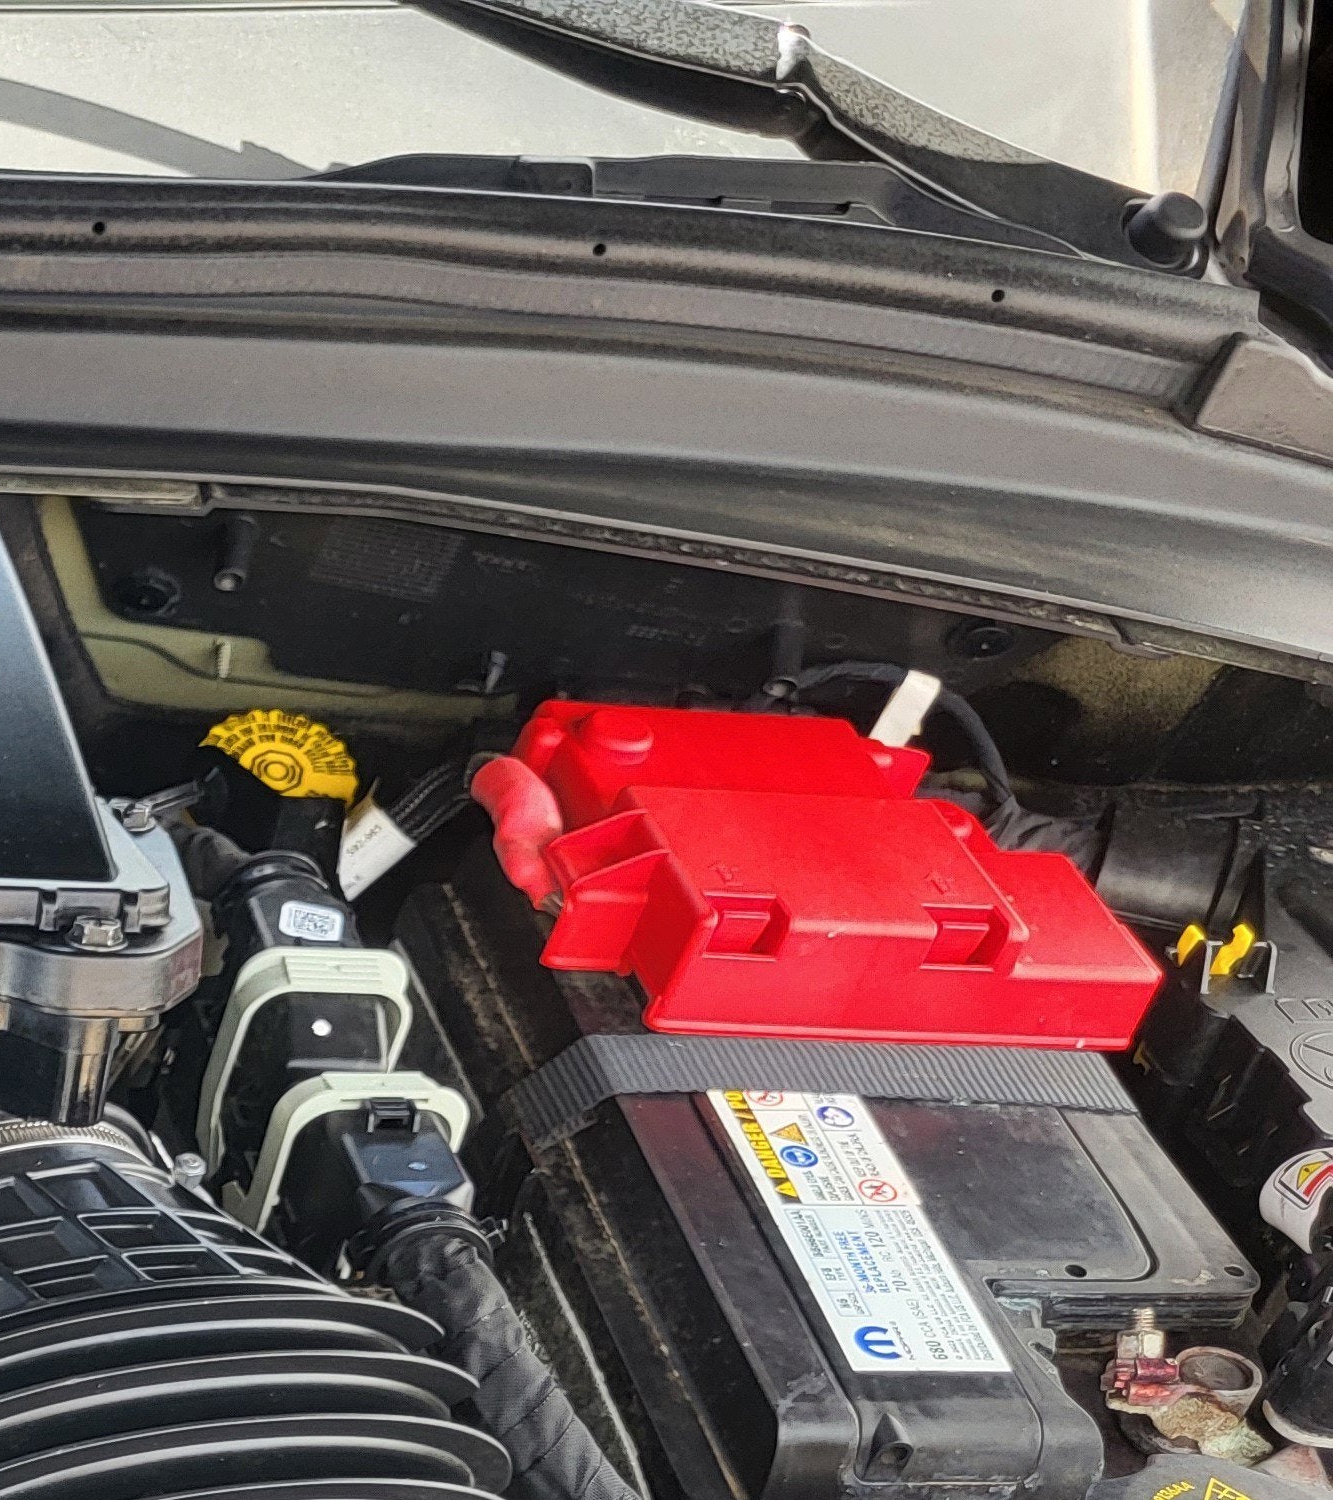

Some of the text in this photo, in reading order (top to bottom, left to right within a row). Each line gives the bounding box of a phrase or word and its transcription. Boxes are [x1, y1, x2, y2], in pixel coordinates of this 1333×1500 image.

[738, 1121, 787, 1178] DANGER
[830, 1230, 853, 1250] FREE
[862, 1231, 887, 1248] 120
[846, 1230, 892, 1293] REPLACEMENT
[889, 1279, 912, 1293] 70
[915, 1321, 937, 1338] CCA
[923, 1339, 950, 1360] 680
